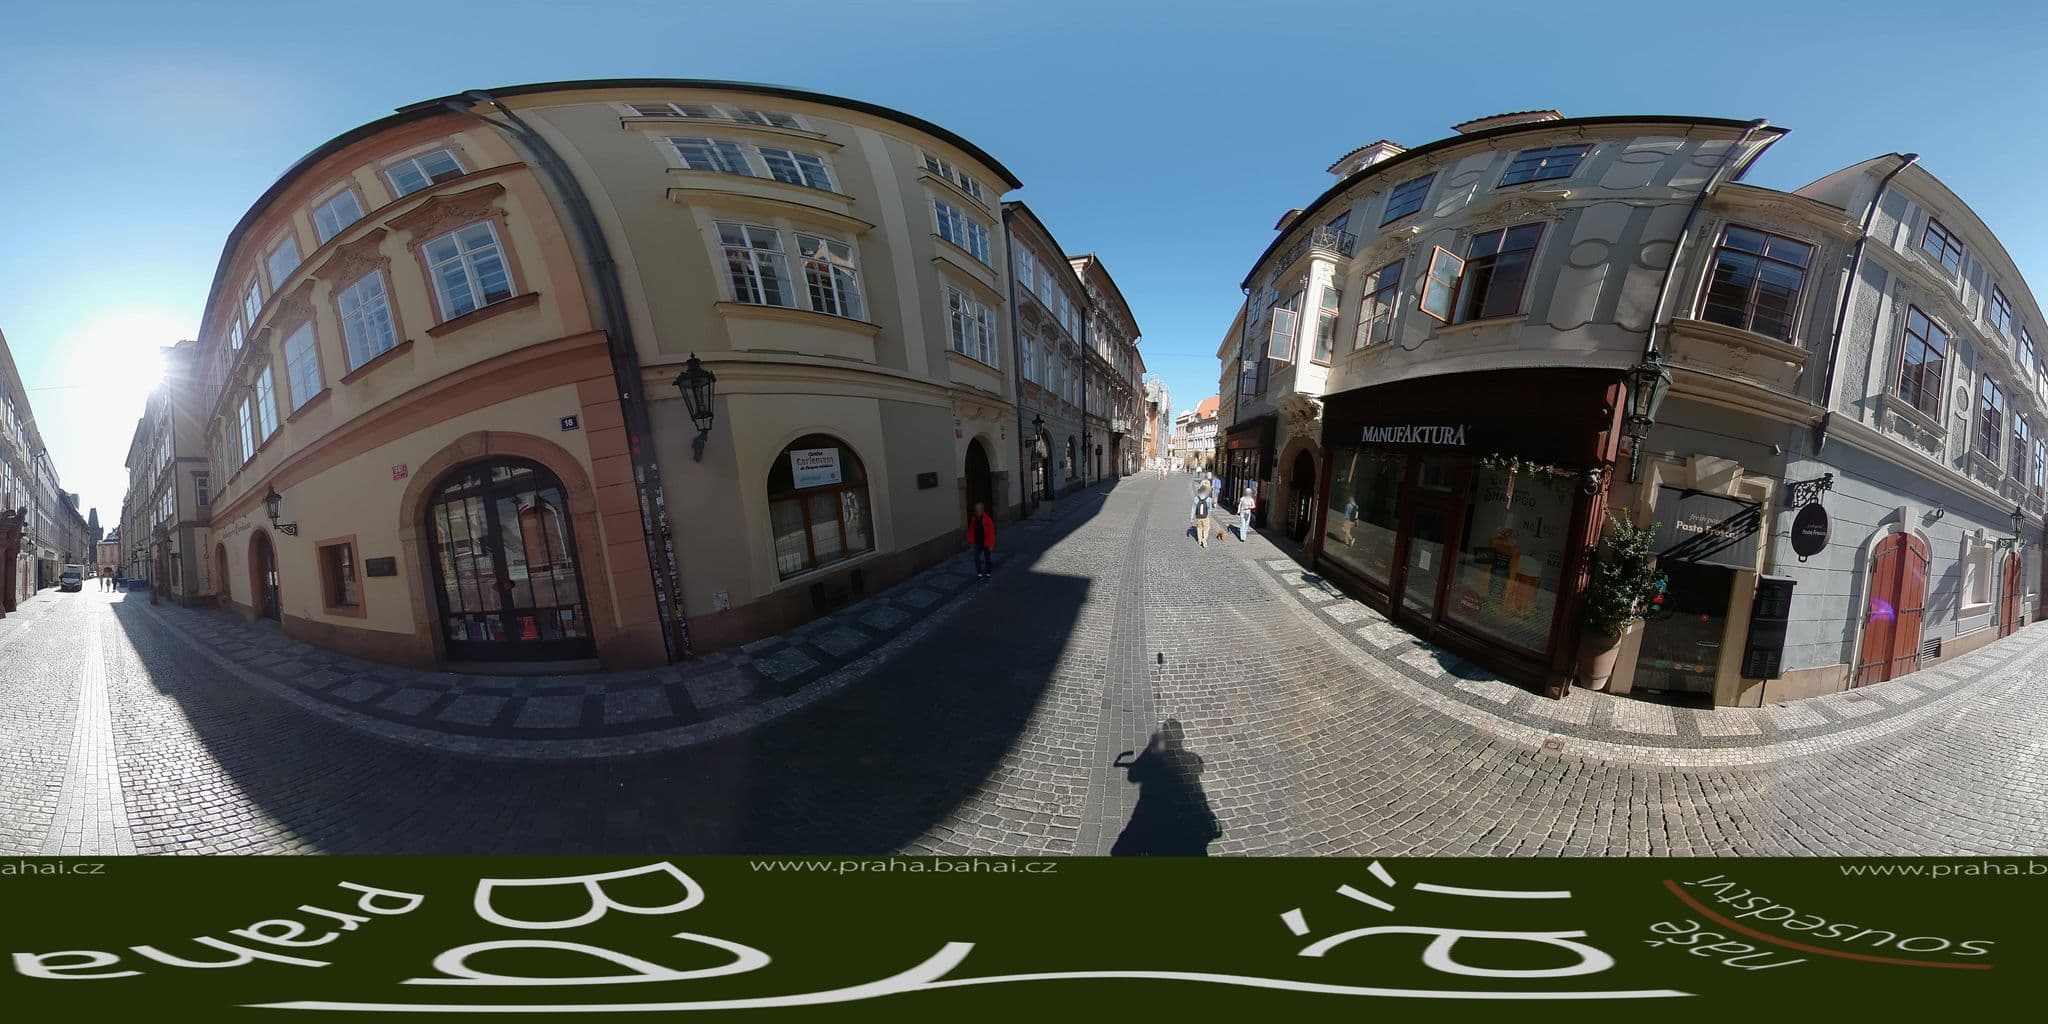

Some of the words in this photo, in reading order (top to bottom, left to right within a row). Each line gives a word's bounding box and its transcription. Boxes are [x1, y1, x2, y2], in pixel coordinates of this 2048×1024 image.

[564, 418, 574, 427] 18
[1361, 423, 1466, 446] MANUFAKTURA
[1676, 520, 1704, 533] Pasta
